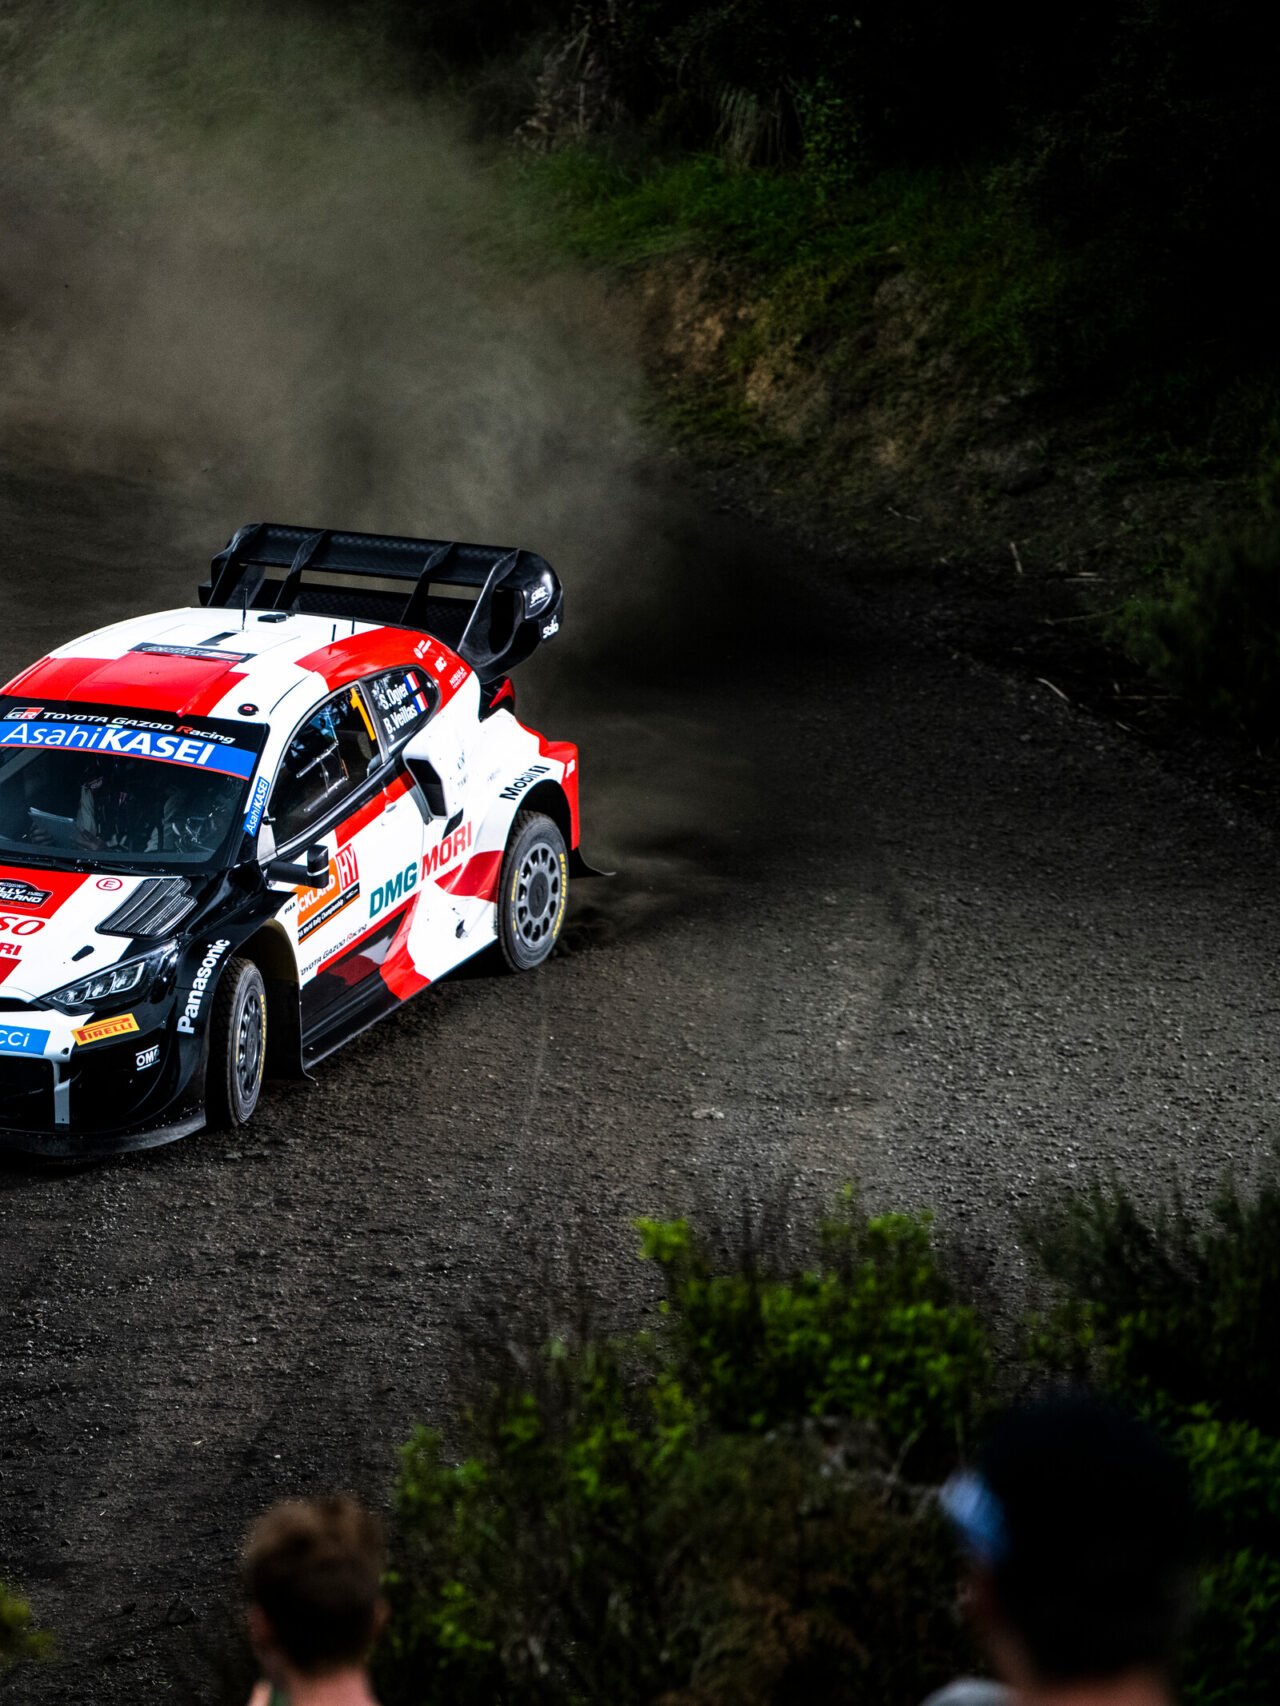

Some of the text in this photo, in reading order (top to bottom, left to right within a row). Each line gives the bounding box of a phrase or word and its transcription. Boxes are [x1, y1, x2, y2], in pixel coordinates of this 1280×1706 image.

[6, 710, 236, 744] GR TOYOTA GAZOO Racing
[350, 687, 376, 741] 1
[1, 723, 216, 765] AsahiKASEI
[246, 780, 269, 834] AsahiKASEI
[499, 771, 541, 801] Mobil
[337, 848, 357, 890] HY
[369, 821, 472, 918] DMG MORI
[177, 939, 231, 1034] Panasonic
[76, 1017, 133, 1042] PIRELLI
